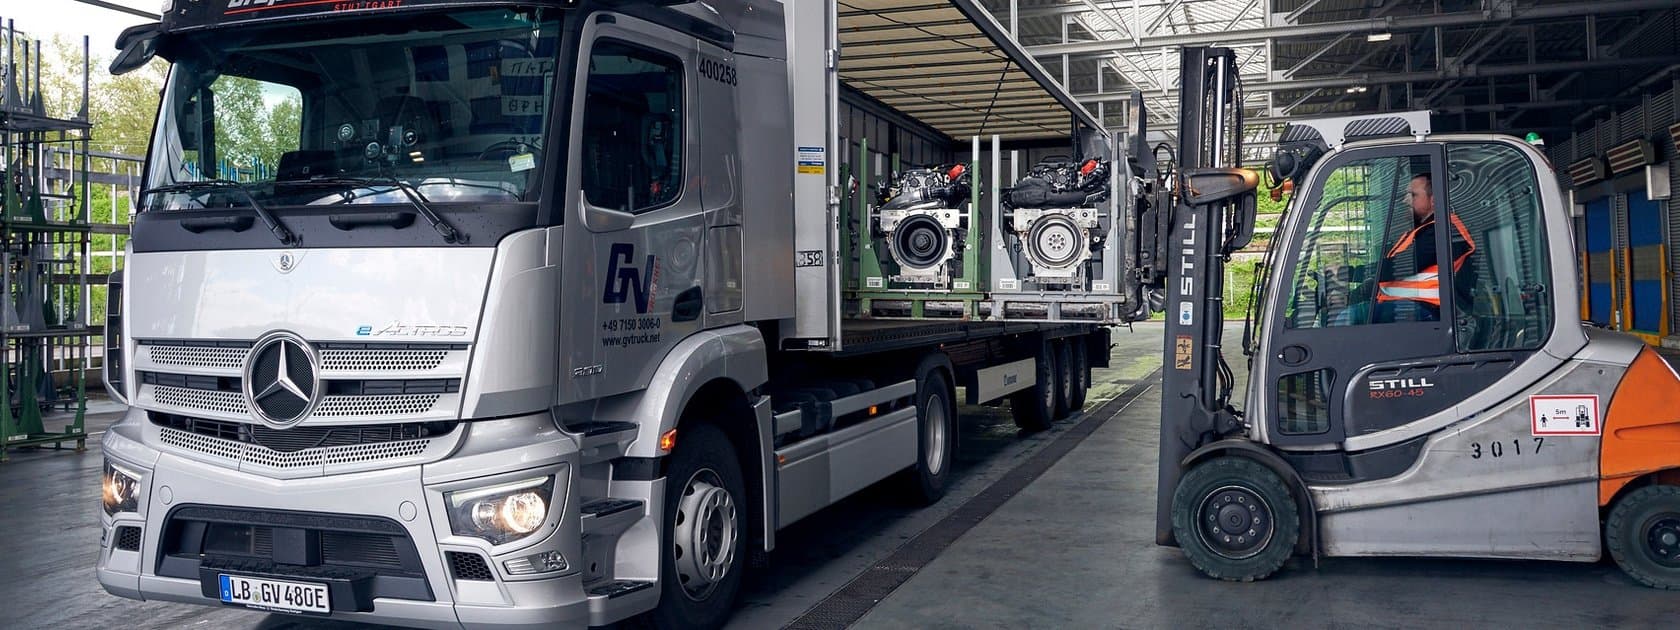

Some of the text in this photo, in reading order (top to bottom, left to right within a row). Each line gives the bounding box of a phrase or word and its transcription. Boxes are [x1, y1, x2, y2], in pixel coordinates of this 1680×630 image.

[334, 0, 403, 12] STUTTGART
[699, 58, 737, 87] 400258
[1180, 213, 1197, 296] STILL
[602, 317, 661, 331] +49 7150 3006-0
[602, 333, 660, 348] www.gvtruck.net
[1369, 378, 1434, 390] STILL
[1368, 388, 1425, 399] RX60-45
[231, 579, 251, 600] LB
[261, 583, 281, 604] GV
[284, 585, 326, 609] 480E
